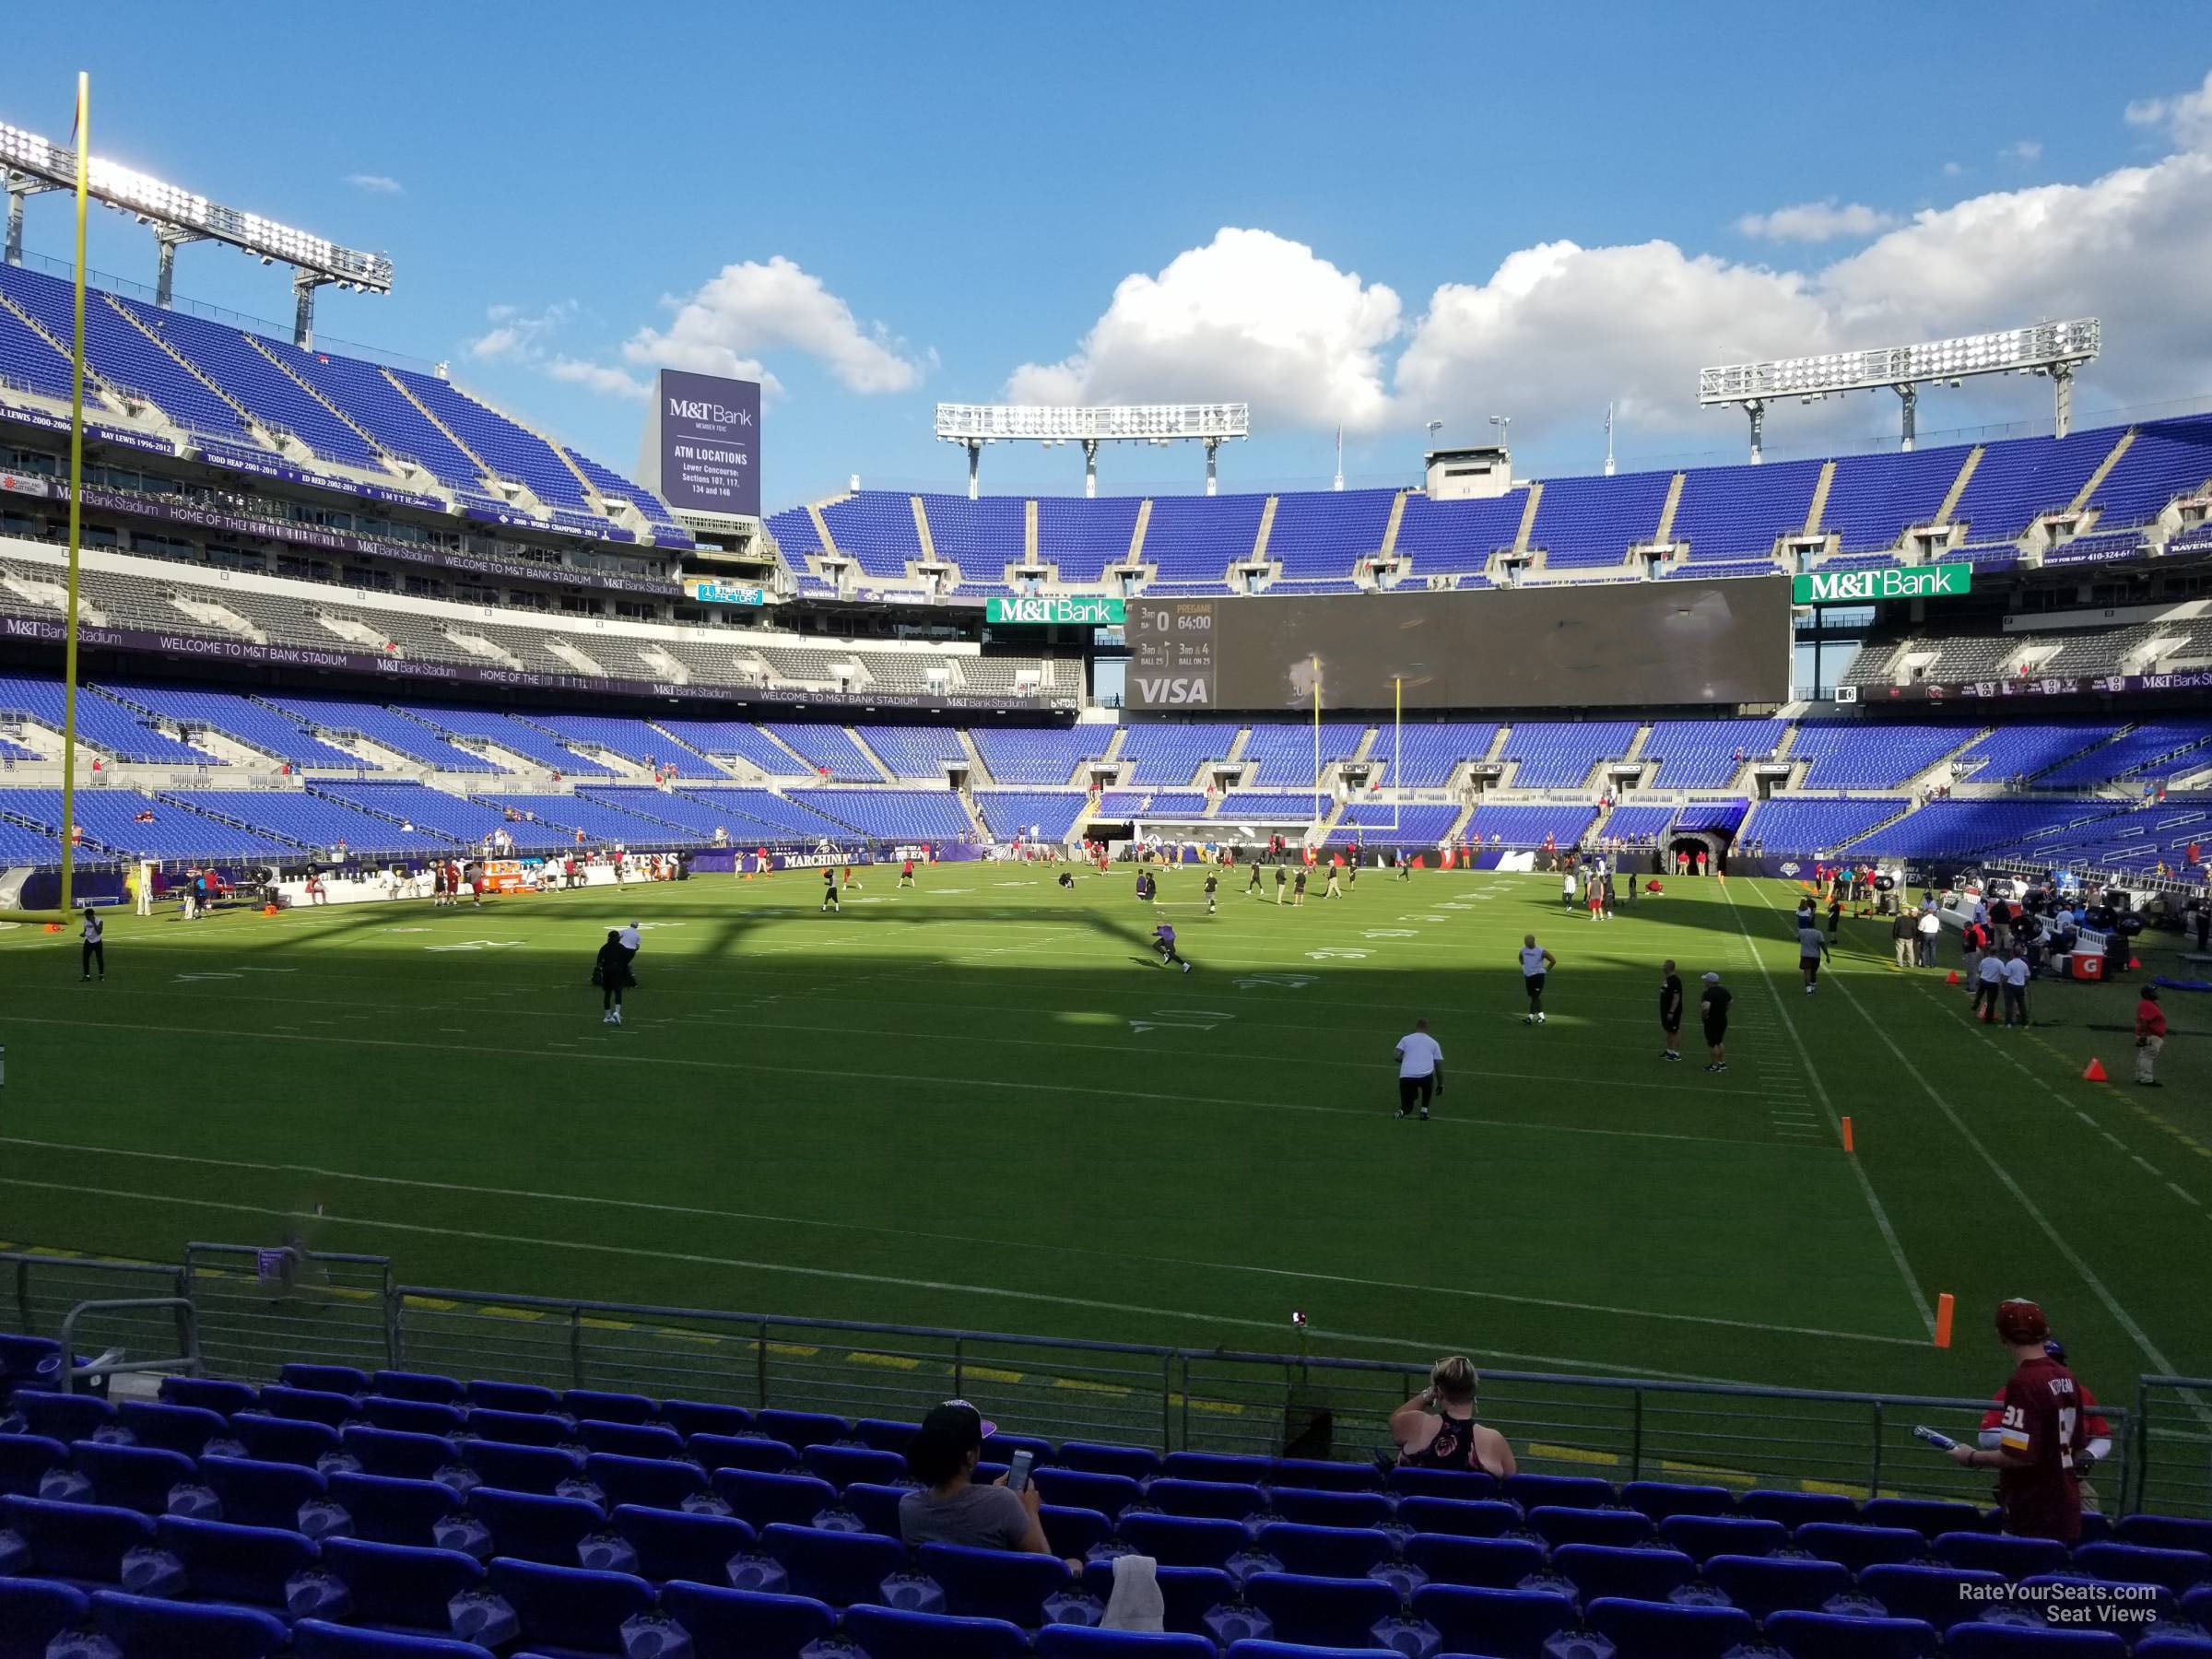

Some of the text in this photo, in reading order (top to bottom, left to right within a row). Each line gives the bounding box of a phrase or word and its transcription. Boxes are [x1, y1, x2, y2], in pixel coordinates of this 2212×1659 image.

[6, 410, 31, 422] LEWIS
[32, 416, 72, 430] 2000-2006
[669, 398, 752, 427] M&T Bank
[101, 431, 171, 453] RAY LEWIS 1996-2012
[675, 445, 747, 465] ATM LOCATIONS
[207, 453, 277, 476] TODD HEAP 2001-2010
[683, 463, 702, 472] Lower
[302, 474, 357, 492] ED REED 2002-2012
[682, 473, 710, 484] Sections
[381, 491, 411, 505] SMYTH
[693, 485, 704, 494] 134
[87, 491, 113, 507] Bank
[114, 496, 159, 517] Stadium
[170, 508, 203, 523] HOME
[206, 513, 221, 525] OF
[531, 520, 549, 529] WORLD
[551, 524, 582, 535] CHAMPIONS
[584, 529, 598, 537] 2012
[357, 539, 434, 563] M&T Bank Stadium
[445, 555, 591, 584] WELCOME TO M&T BANK STADIUM
[603, 577, 679, 594] M&T Bank Stadium
[1810, 567, 1952, 600] M&T Bank
[714, 594, 759, 602] FACTORY
[999, 599, 1112, 621] M&T Bank
[1177, 604, 1212, 614] PREGAME
[1157, 611, 1170, 631] 0
[1177, 616, 1211, 629] 64:00
[6, 618, 41, 636] M&T
[76, 626, 122, 644] Stadium
[160, 636, 347, 666] WELCOME TO M&T BANK STADIUM
[1179, 643, 1193, 654] 3RD
[1202, 642, 1208, 654] 4
[377, 658, 456, 677] M&T Bank Stadium
[480, 670, 506, 682] HOME
[508, 672, 521, 683] OF
[523, 674, 538, 685] THE
[2142, 675, 2173, 688] M&T
[2173, 674, 2201, 688] Bank
[653, 684, 732, 698] M&T Bank Stadium
[760, 691, 918, 705] WELCOME TO M&T BANK STADIUM
[1134, 677, 1207, 703] VISA
[1845, 689, 1853, 700] 0
[947, 697, 1028, 708] M&T Bank Stadium
